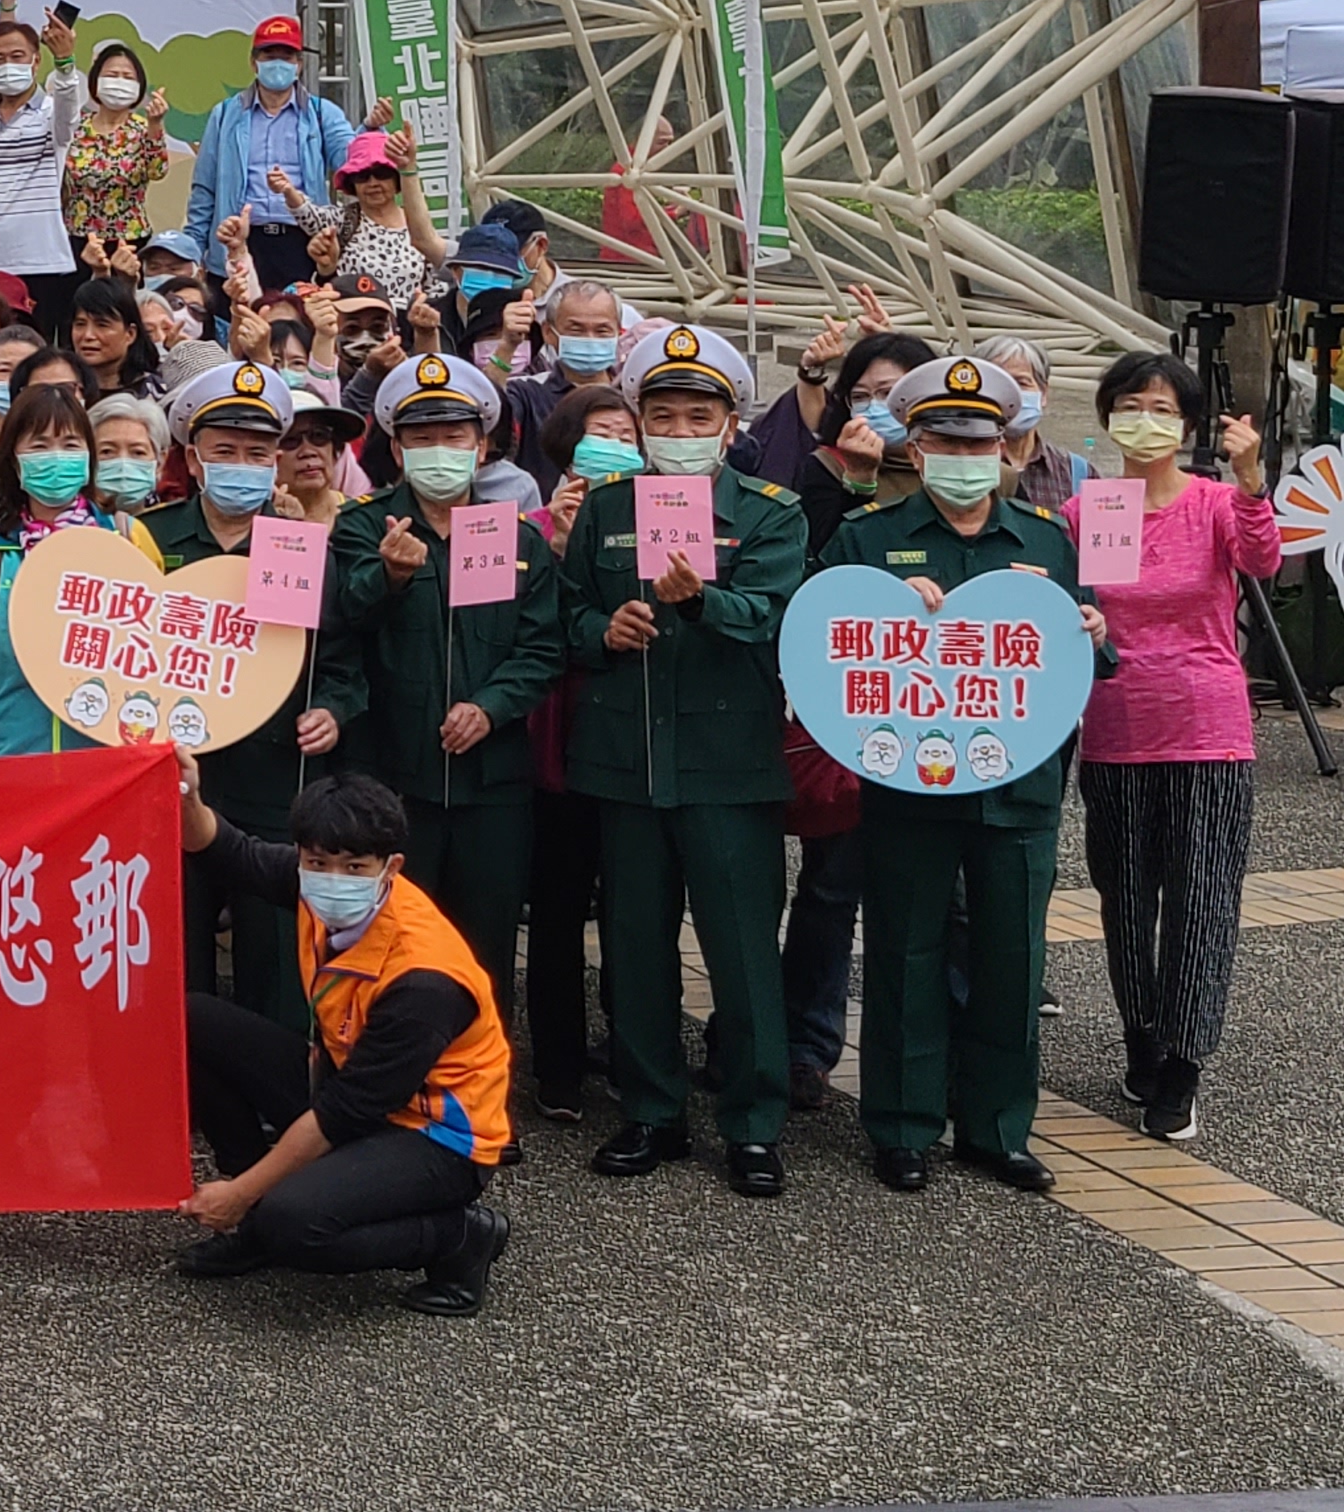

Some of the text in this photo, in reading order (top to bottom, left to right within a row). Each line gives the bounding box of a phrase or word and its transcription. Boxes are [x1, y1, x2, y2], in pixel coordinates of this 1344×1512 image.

[57, 574, 260, 652] 郵政壽險
[830, 619, 1041, 668] 郵政壽險
[63, 622, 236, 695] 關心您!
[846, 670, 1026, 718] 關心您!
